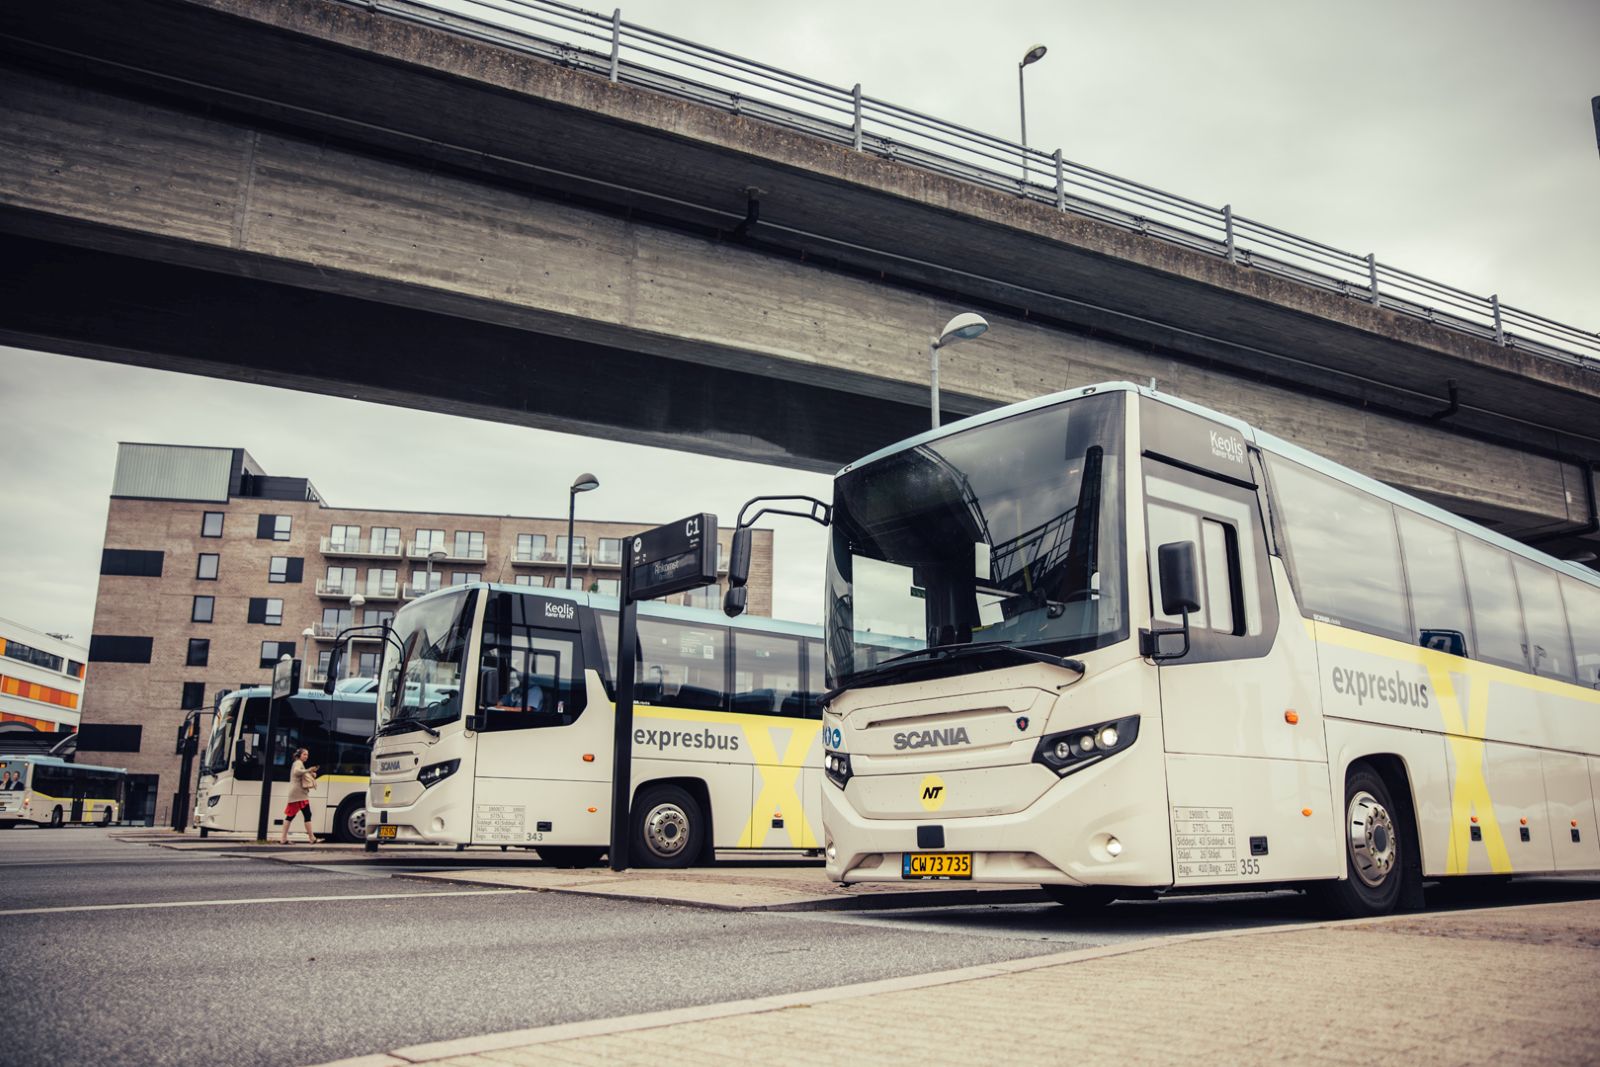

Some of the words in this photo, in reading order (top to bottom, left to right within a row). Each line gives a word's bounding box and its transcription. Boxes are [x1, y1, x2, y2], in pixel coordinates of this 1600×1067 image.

[1209, 430, 1243, 456] Keolis
[685, 518, 700, 537] C1
[545, 602, 574, 614] Keolis
[1332, 666, 1429, 709] expresbus
[633, 728, 739, 751] expresbus
[893, 727, 971, 751] SCANIA
[380, 760, 400, 771] SCANIA
[922, 786, 943, 800] NT
[526, 832, 544, 842] 343
[911, 857, 926, 872] CW
[930, 857, 944, 872] 73
[946, 856, 969, 872] 735
[1240, 858, 1260, 876] 355
